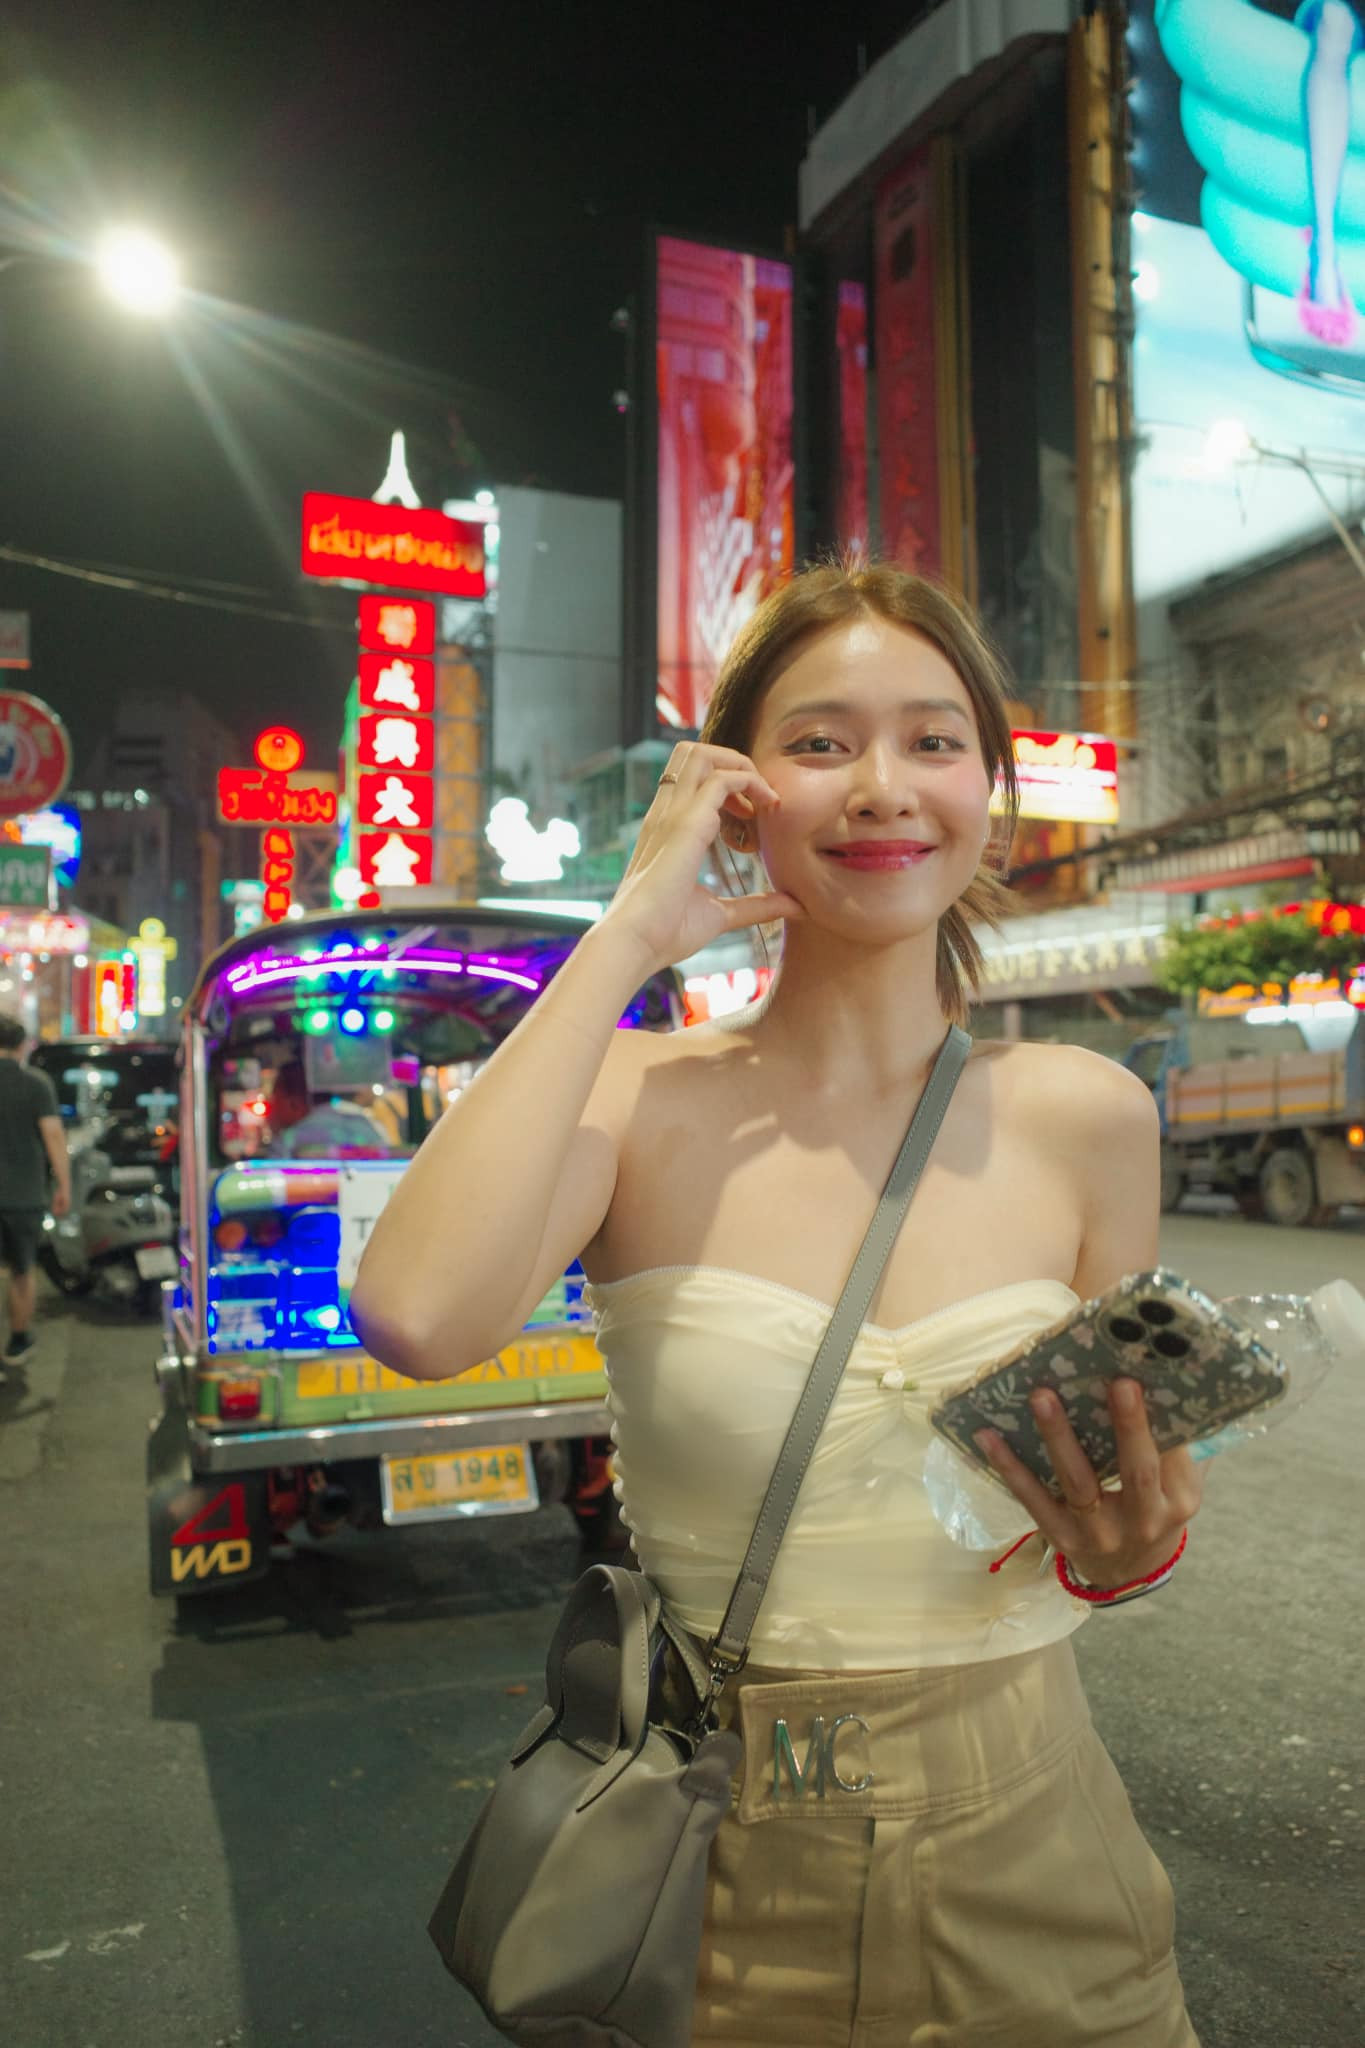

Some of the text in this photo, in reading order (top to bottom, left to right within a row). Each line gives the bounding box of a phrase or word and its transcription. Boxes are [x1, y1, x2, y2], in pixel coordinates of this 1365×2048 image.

[329, 1339, 575, 1394] THAND
[452, 1452, 520, 1486] 1948
[773, 1714, 875, 1800] MC
